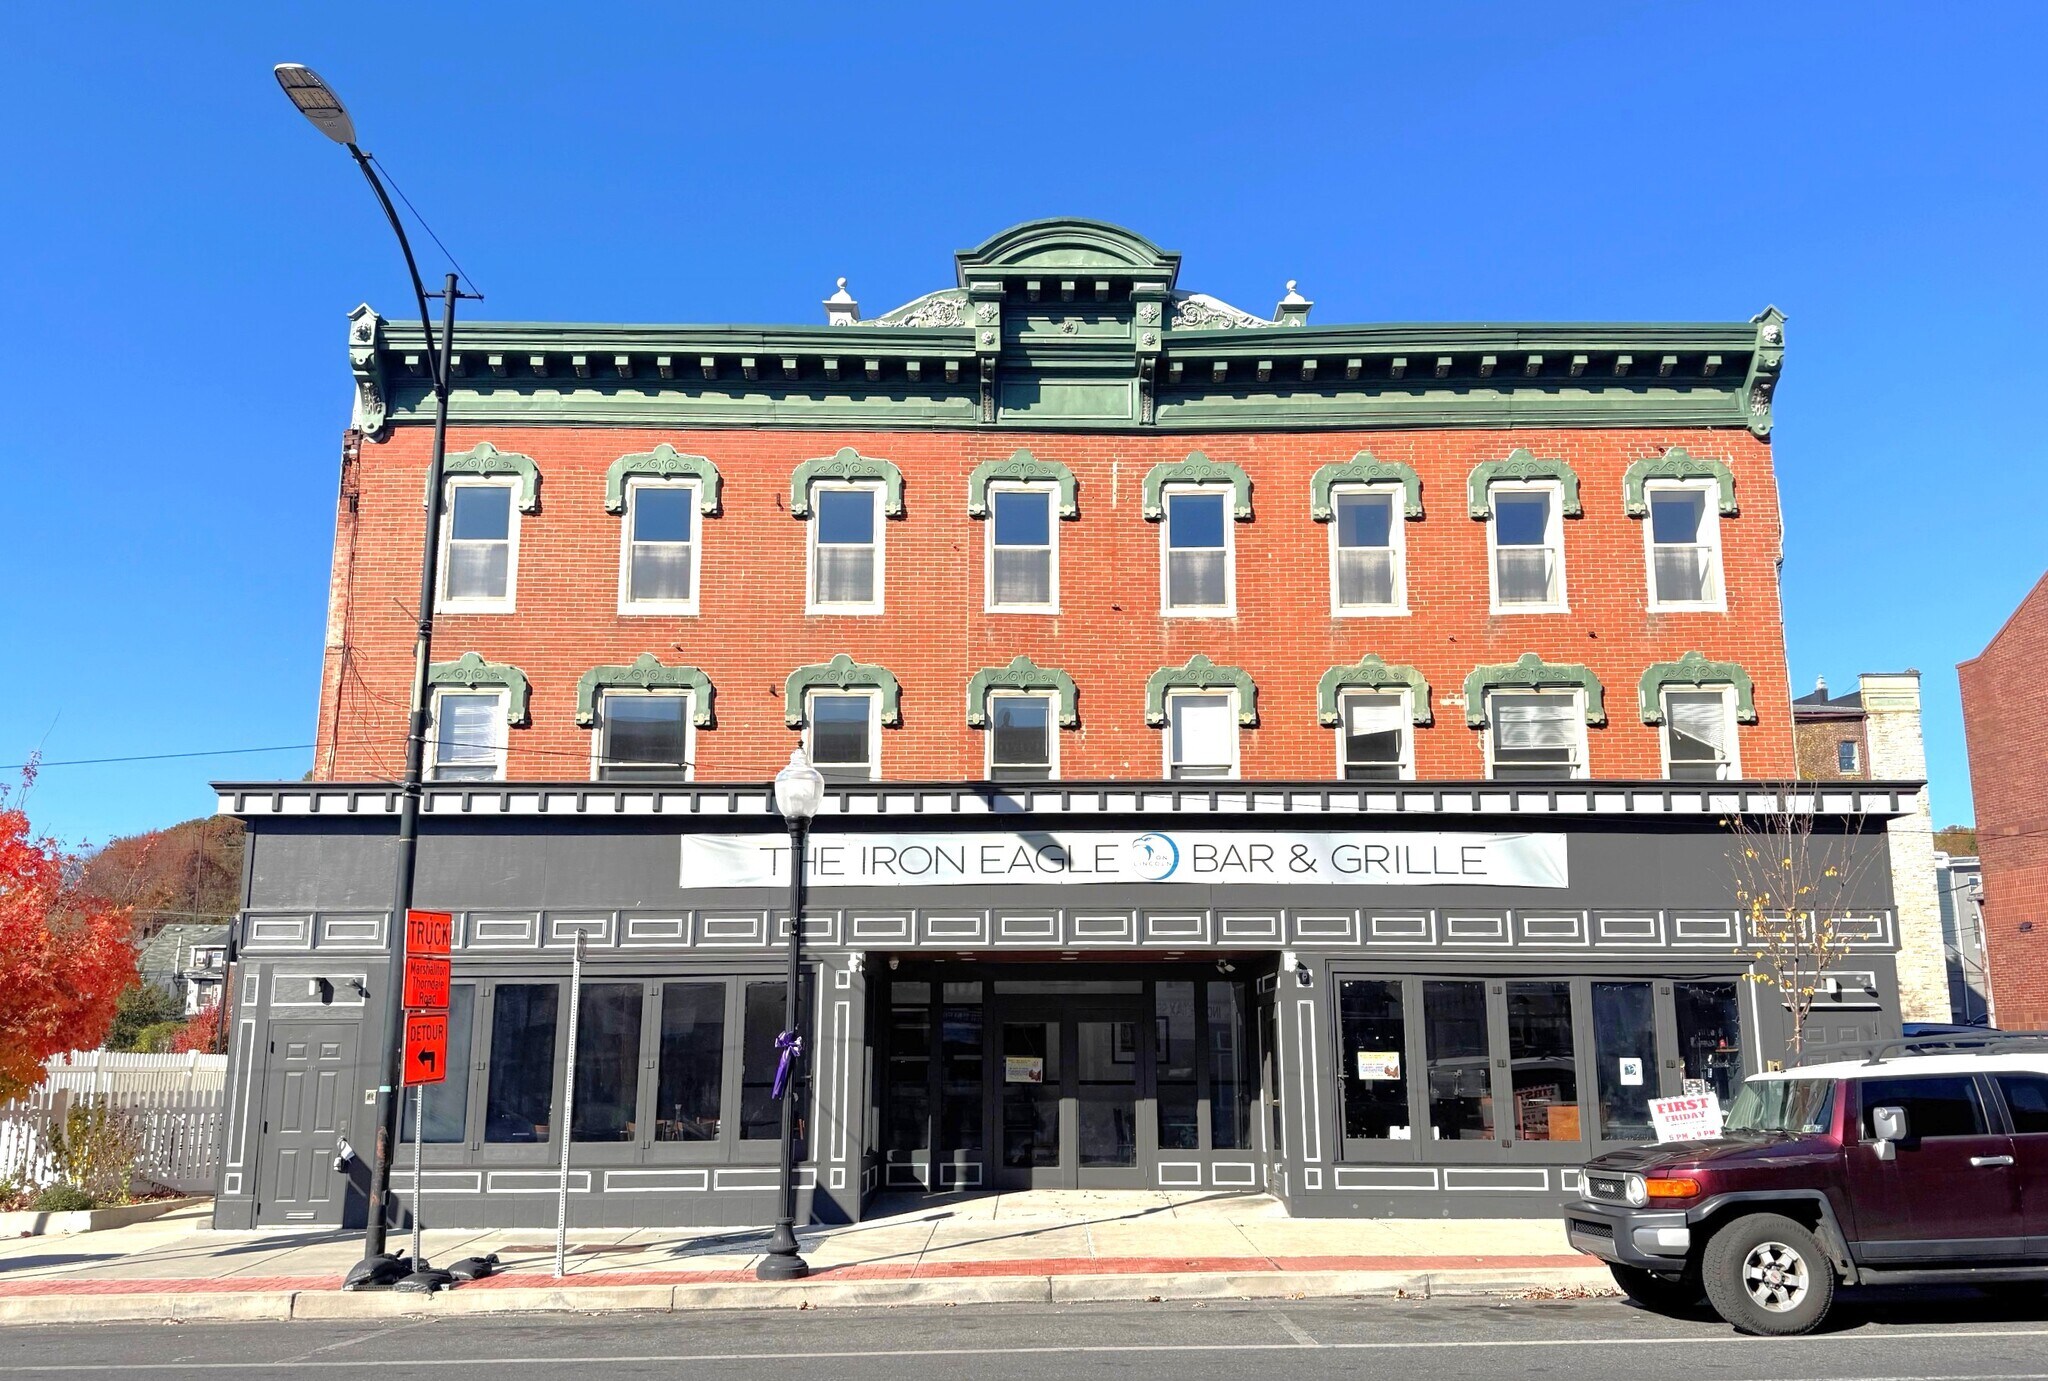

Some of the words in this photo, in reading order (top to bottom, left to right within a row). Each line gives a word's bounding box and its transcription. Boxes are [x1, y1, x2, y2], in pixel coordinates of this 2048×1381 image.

[759, 846, 845, 876] THE
[862, 845, 965, 876] IRON
[981, 844, 1119, 874] EAGLE
[1193, 844, 1275, 874] BAR
[1288, 844, 1317, 874] &
[1331, 844, 1487, 876] GRILLE
[410, 920, 449, 946] TRUCK
[412, 976, 445, 990] Thorndale
[419, 991, 437, 1005] Road
[410, 1024, 444, 1042] DETOUR
[1656, 1097, 1709, 1114] FIRST
[1665, 1111, 1705, 1122] FRIDAY
